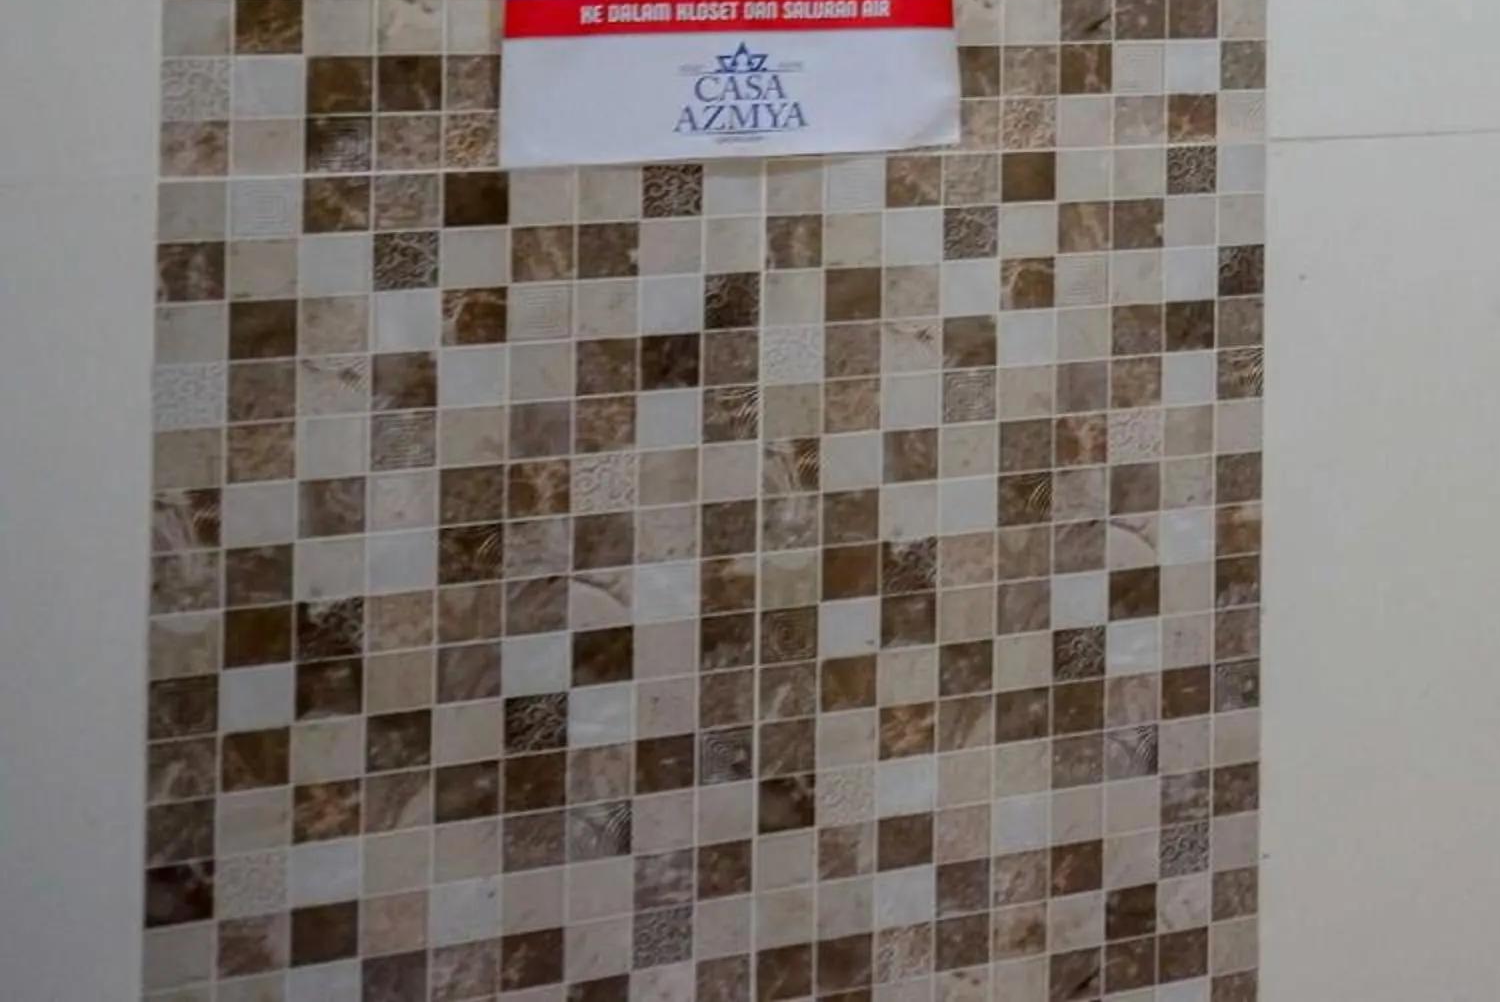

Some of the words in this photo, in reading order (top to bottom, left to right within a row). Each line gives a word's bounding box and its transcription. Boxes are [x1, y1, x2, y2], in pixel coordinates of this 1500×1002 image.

[580, 4, 604, 25] KE
[607, 2, 672, 23] DALAM
[675, 0, 738, 21] KLOSET
[743, 0, 778, 20] DAN
[782, 0, 858, 19] SALURAN
[694, 74, 787, 103] CASA
[673, 101, 810, 133] AZMYA
